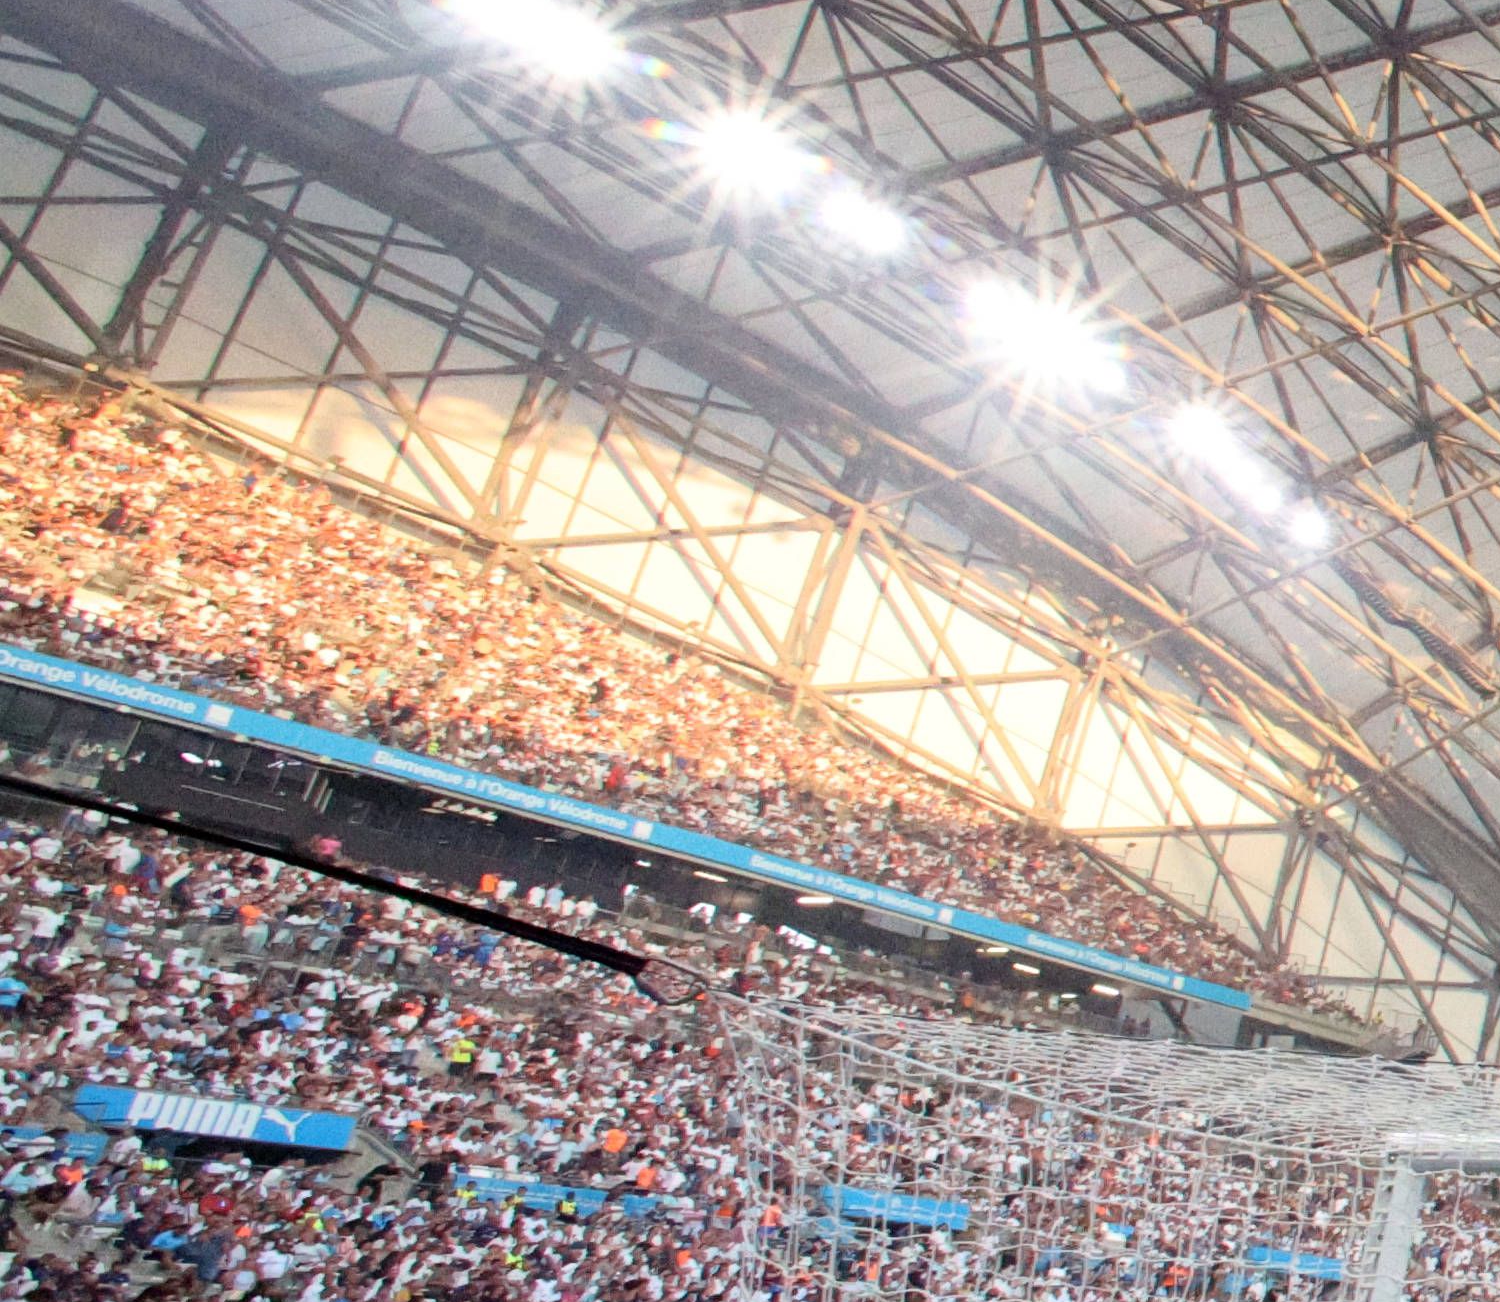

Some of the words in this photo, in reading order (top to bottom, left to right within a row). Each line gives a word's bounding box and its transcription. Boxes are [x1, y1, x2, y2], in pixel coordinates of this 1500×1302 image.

[0, 651, 76, 683] Orange
[81, 671, 196, 714] Vélodrome
[373, 750, 462, 788] Bienvenue
[479, 780, 545, 809] l'Orange
[549, 795, 628, 830] Vélodrome
[127, 1091, 262, 1138] PUMA
